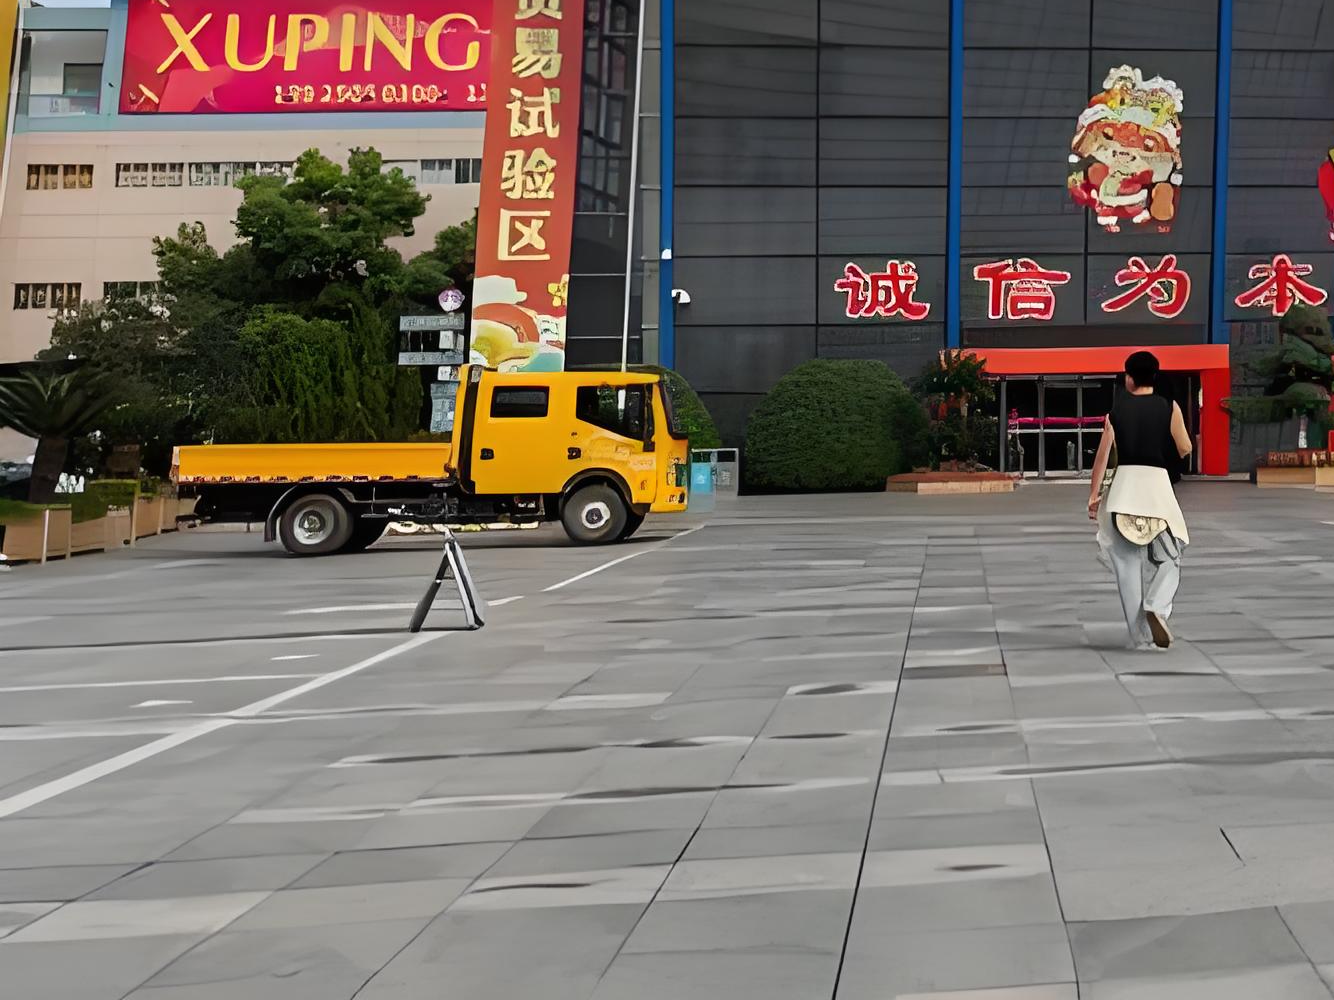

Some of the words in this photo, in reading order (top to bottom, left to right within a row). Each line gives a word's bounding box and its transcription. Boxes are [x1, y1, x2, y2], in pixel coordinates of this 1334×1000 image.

[156, 12, 481, 74] XUPING
[833, 253, 1328, 320] 诚信为本
